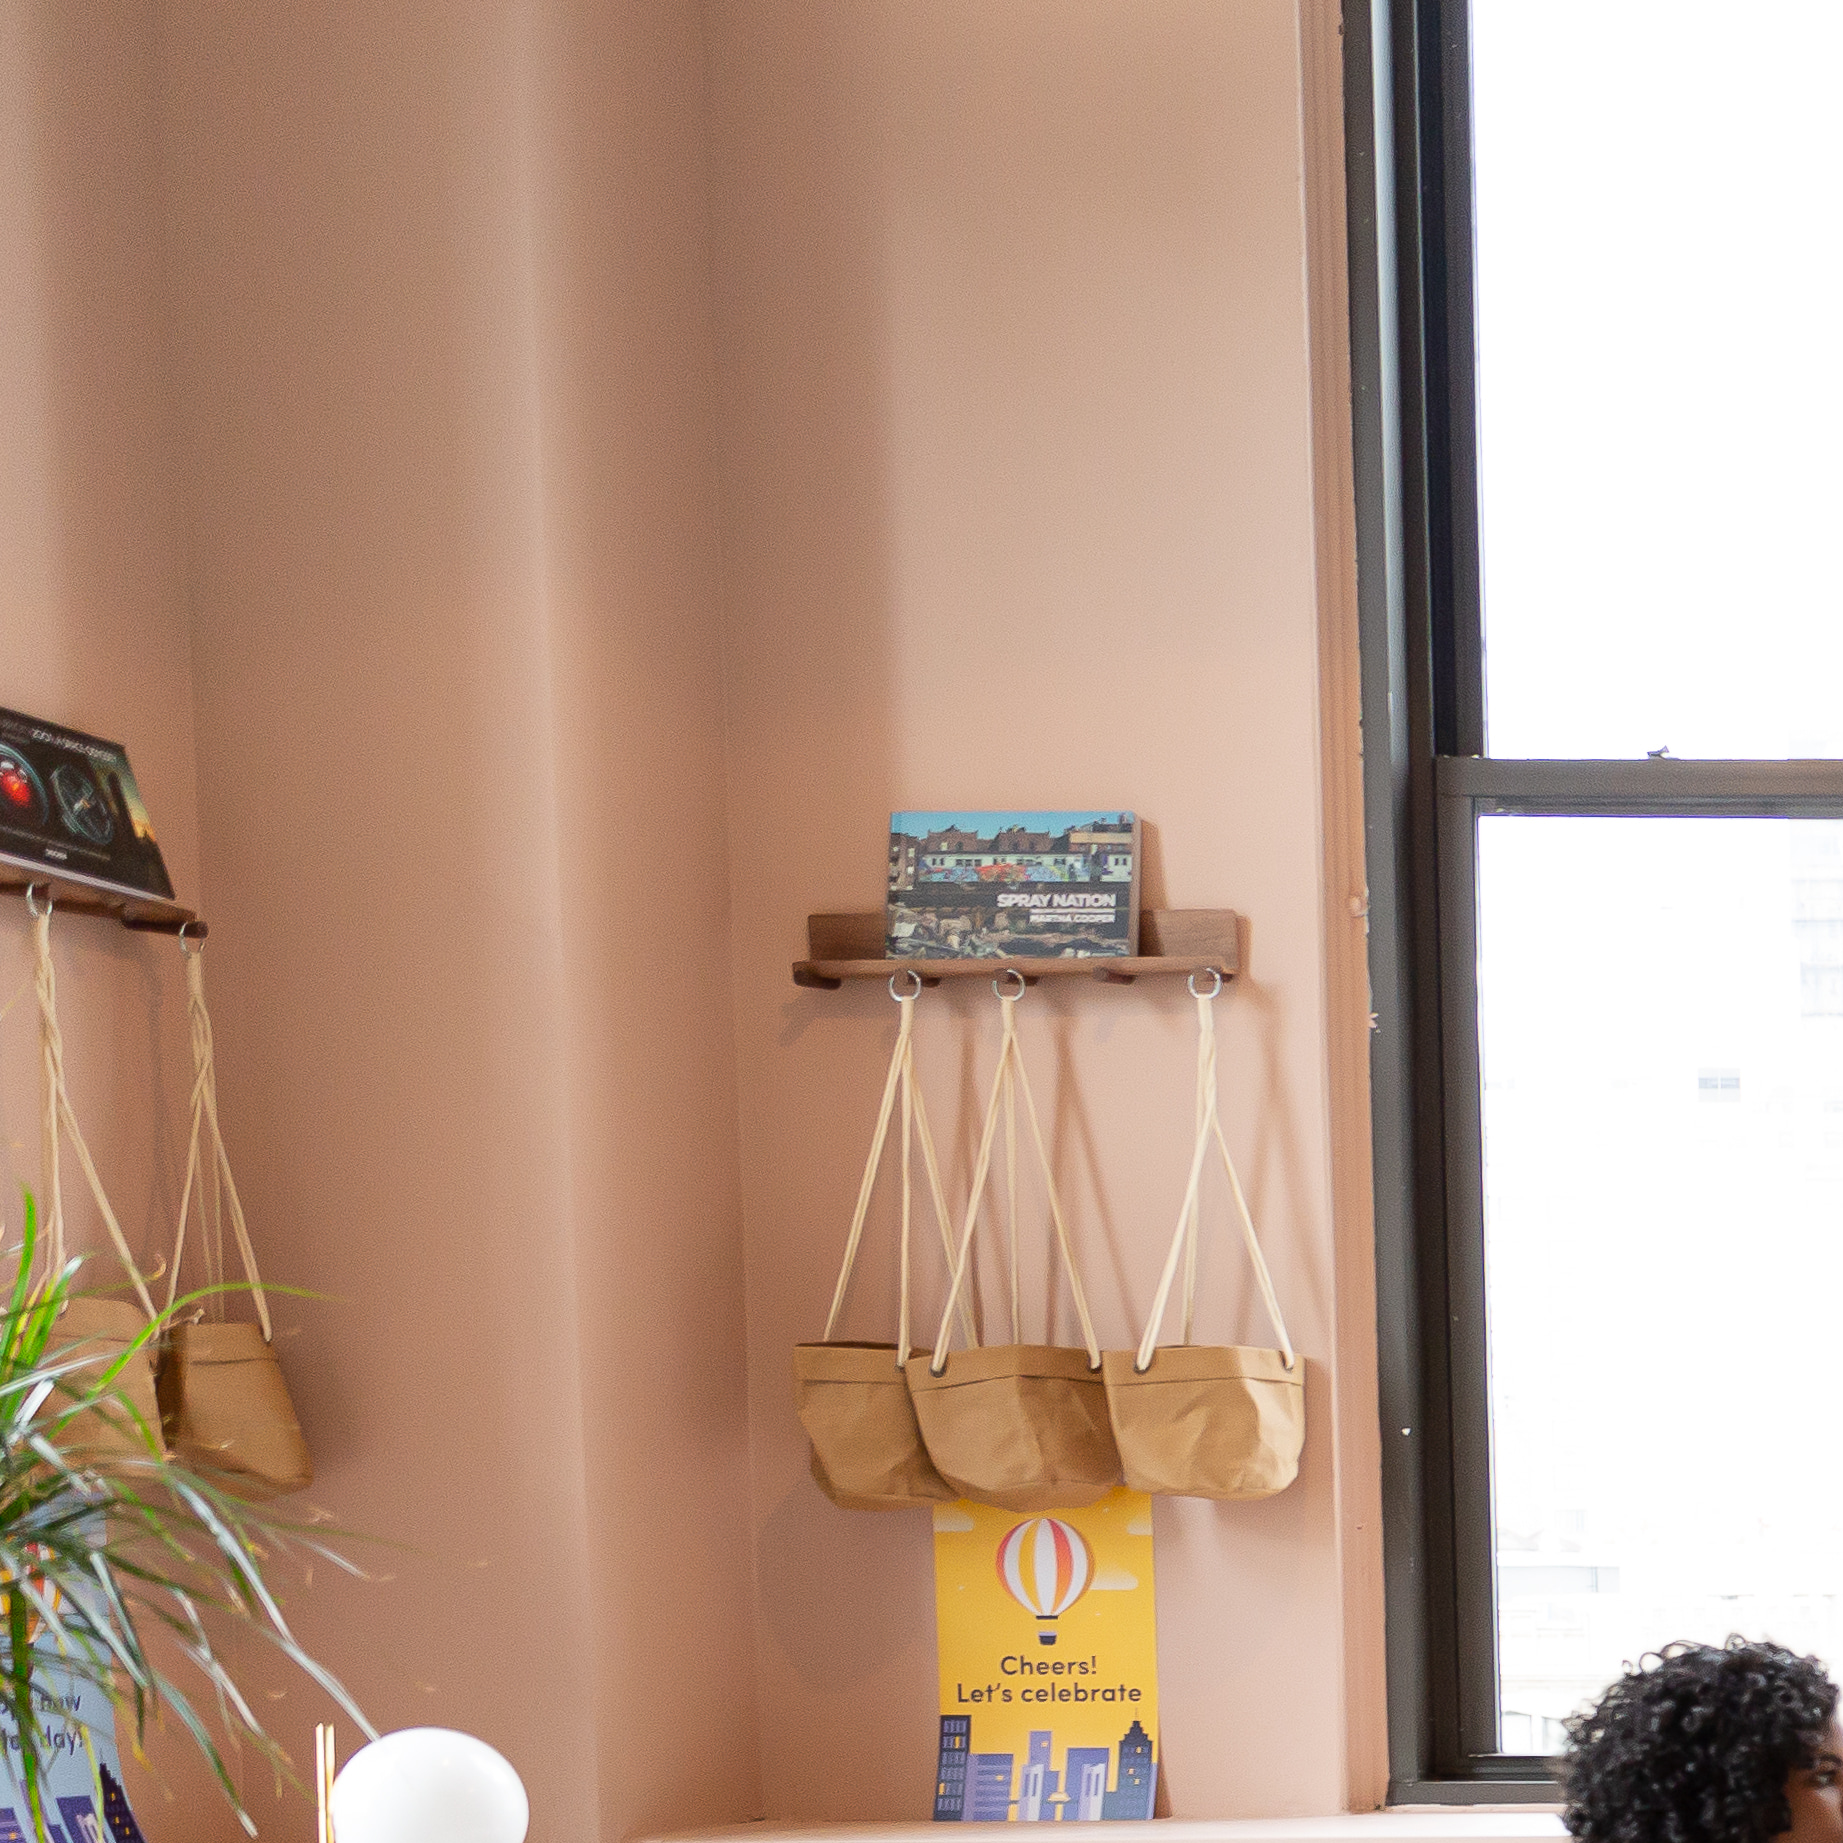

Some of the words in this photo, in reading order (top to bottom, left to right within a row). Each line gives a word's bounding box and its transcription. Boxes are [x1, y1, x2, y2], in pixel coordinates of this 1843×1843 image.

[997, 893, 1052, 908] SPRAY
[1053, 893, 1117, 908] NATION
[1000, 1655, 1097, 1676] Cheers!
[956, 1682, 1013, 1703] Let's
[1021, 1682, 1142, 1703] celebrate
